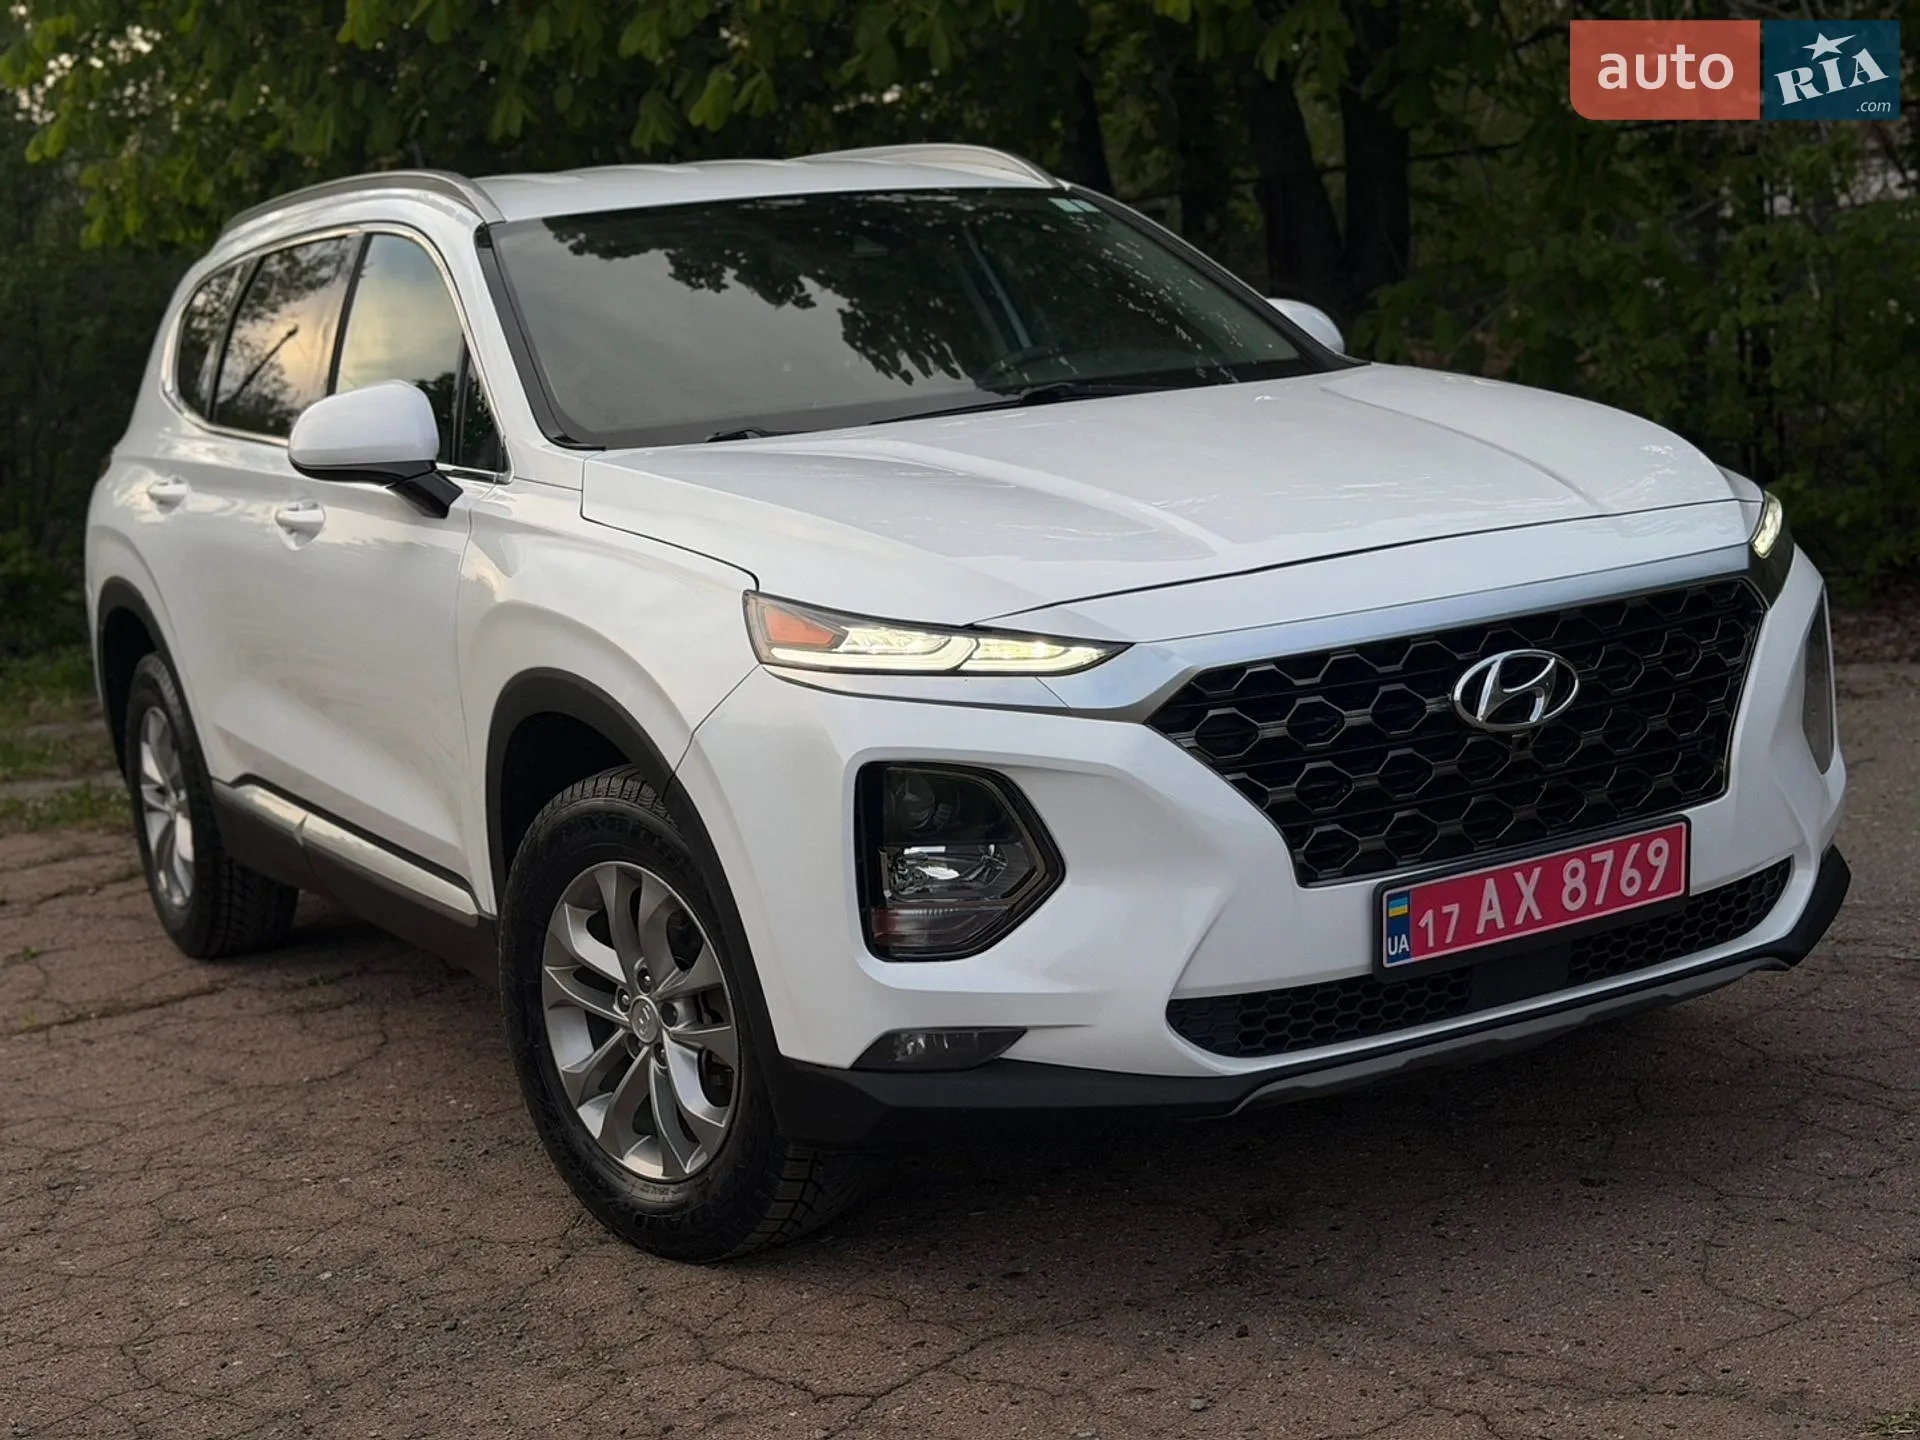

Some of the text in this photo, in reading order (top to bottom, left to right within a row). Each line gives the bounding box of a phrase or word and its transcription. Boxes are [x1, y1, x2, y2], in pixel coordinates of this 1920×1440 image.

[1418, 837, 1670, 948] 17 AX 8769
[1387, 933, 1410, 956] UA
